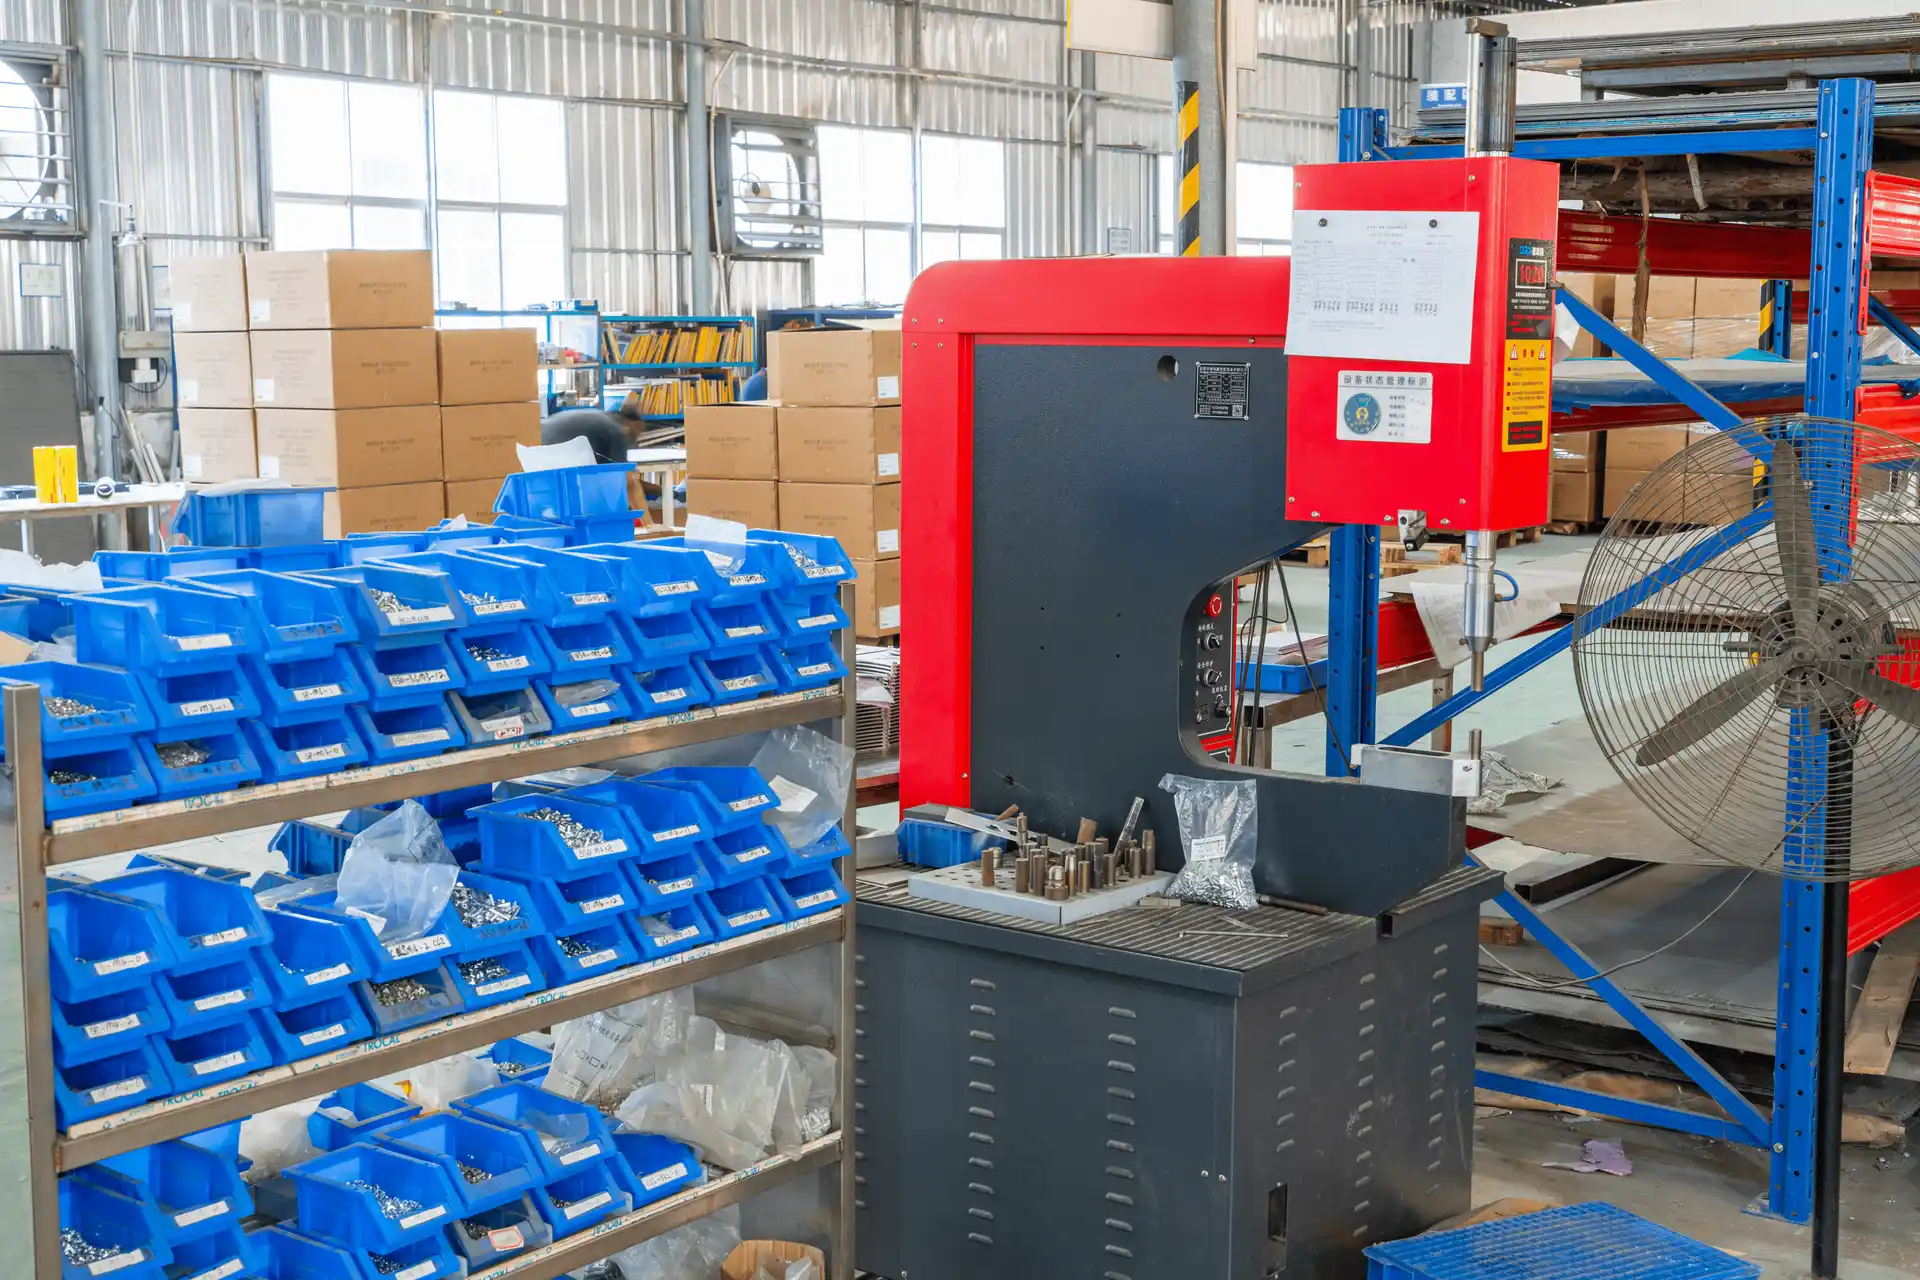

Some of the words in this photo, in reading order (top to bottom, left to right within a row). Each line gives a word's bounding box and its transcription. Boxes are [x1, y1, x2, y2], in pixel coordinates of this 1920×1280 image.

[1343, 375, 1428, 387] 设备状态管理标识
[364, 1035, 401, 1052] TROCAL
